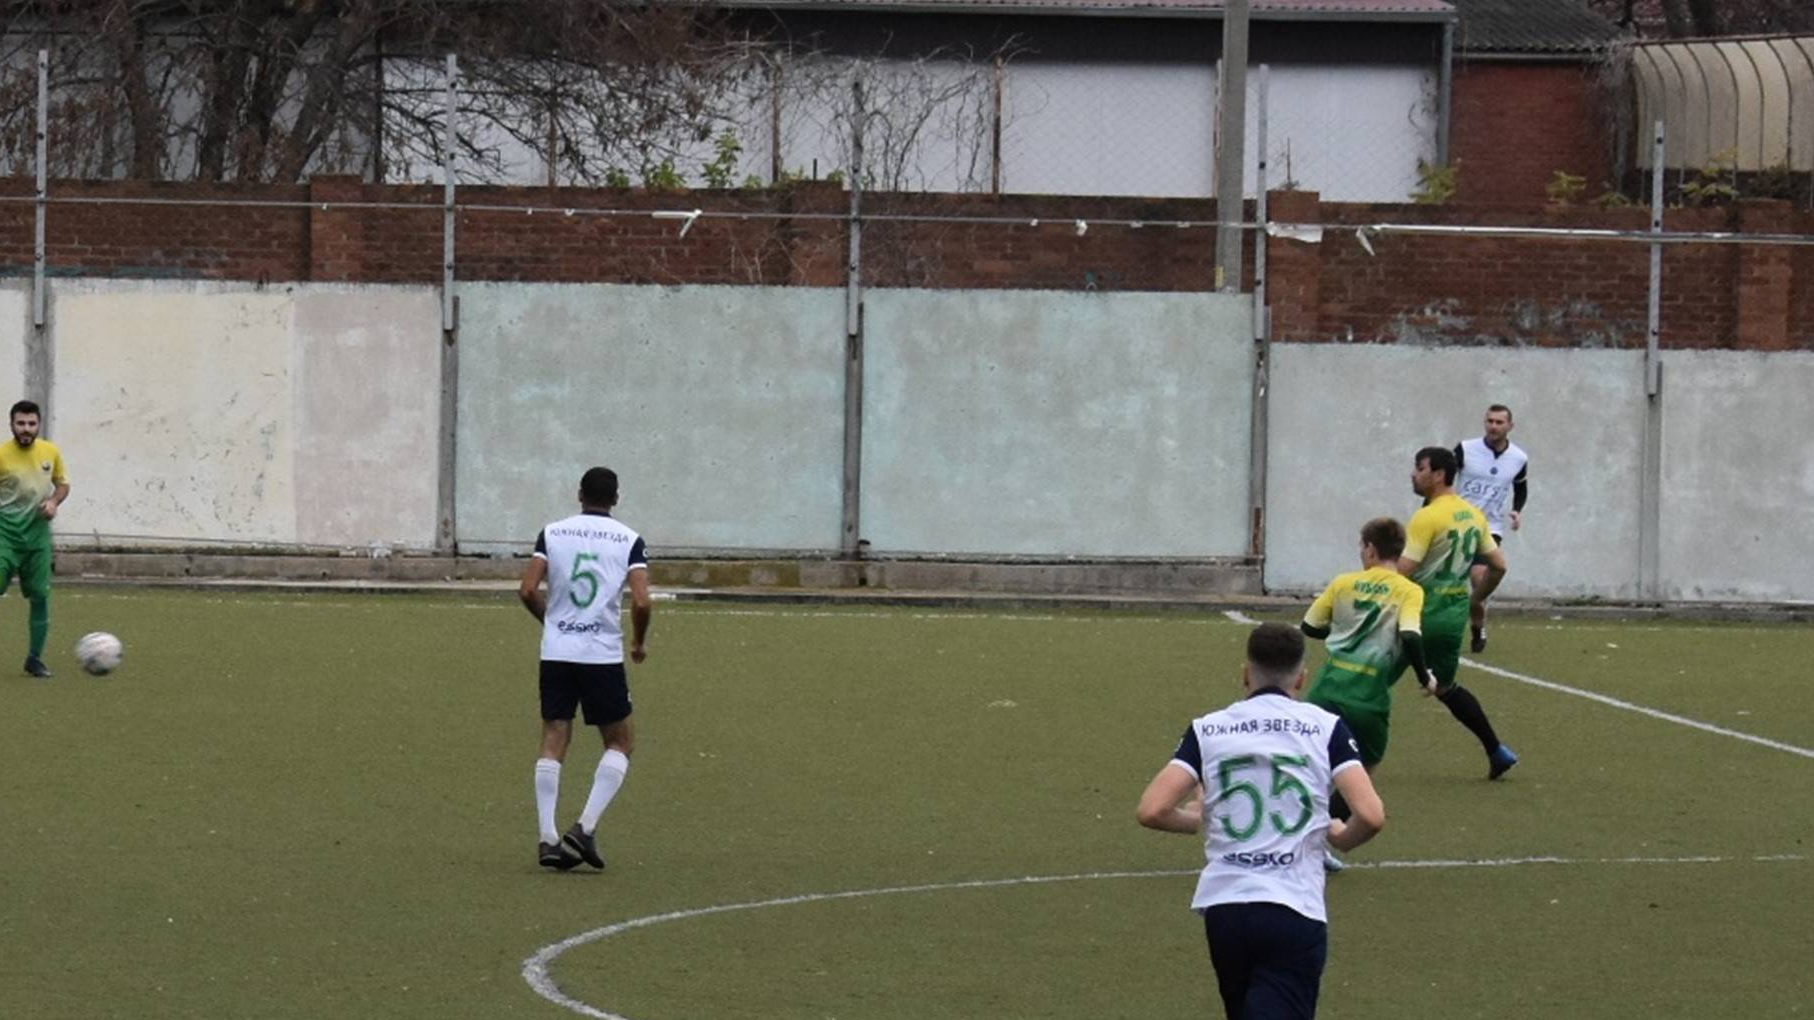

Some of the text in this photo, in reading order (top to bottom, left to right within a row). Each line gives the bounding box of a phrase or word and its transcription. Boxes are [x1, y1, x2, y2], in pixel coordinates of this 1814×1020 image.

[569, 552, 599, 610] 5
[1201, 719, 1321, 737] ЮЖНАЯ ЗВЕЗДА
[1218, 753, 1314, 842] 55
